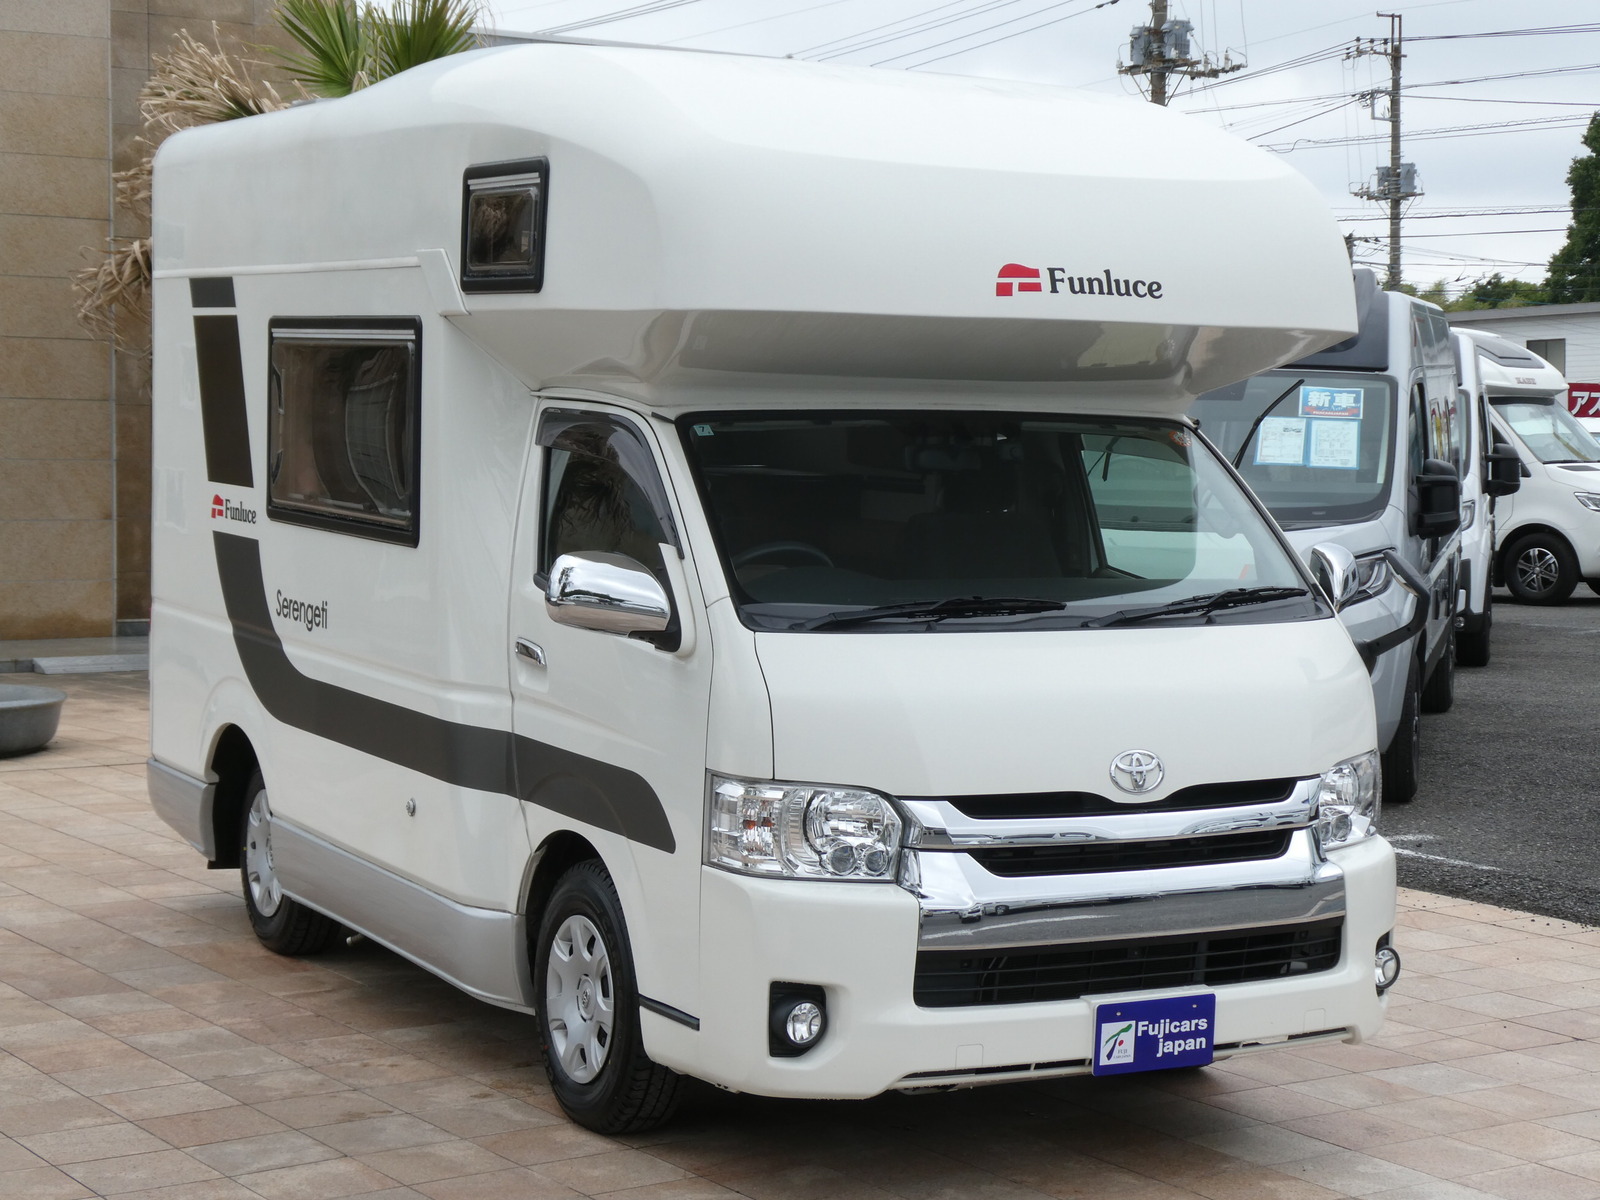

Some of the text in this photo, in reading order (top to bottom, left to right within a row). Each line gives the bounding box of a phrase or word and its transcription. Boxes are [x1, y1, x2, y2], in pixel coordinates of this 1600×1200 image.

[1046, 267, 1163, 299] Funluce
[1308, 390, 1356, 408] 新車
[224, 498, 257, 524] Funluce
[276, 589, 328, 632] Serengeti
[1137, 1018, 1208, 1038] Fujicars
[1156, 1037, 1206, 1057] japan
